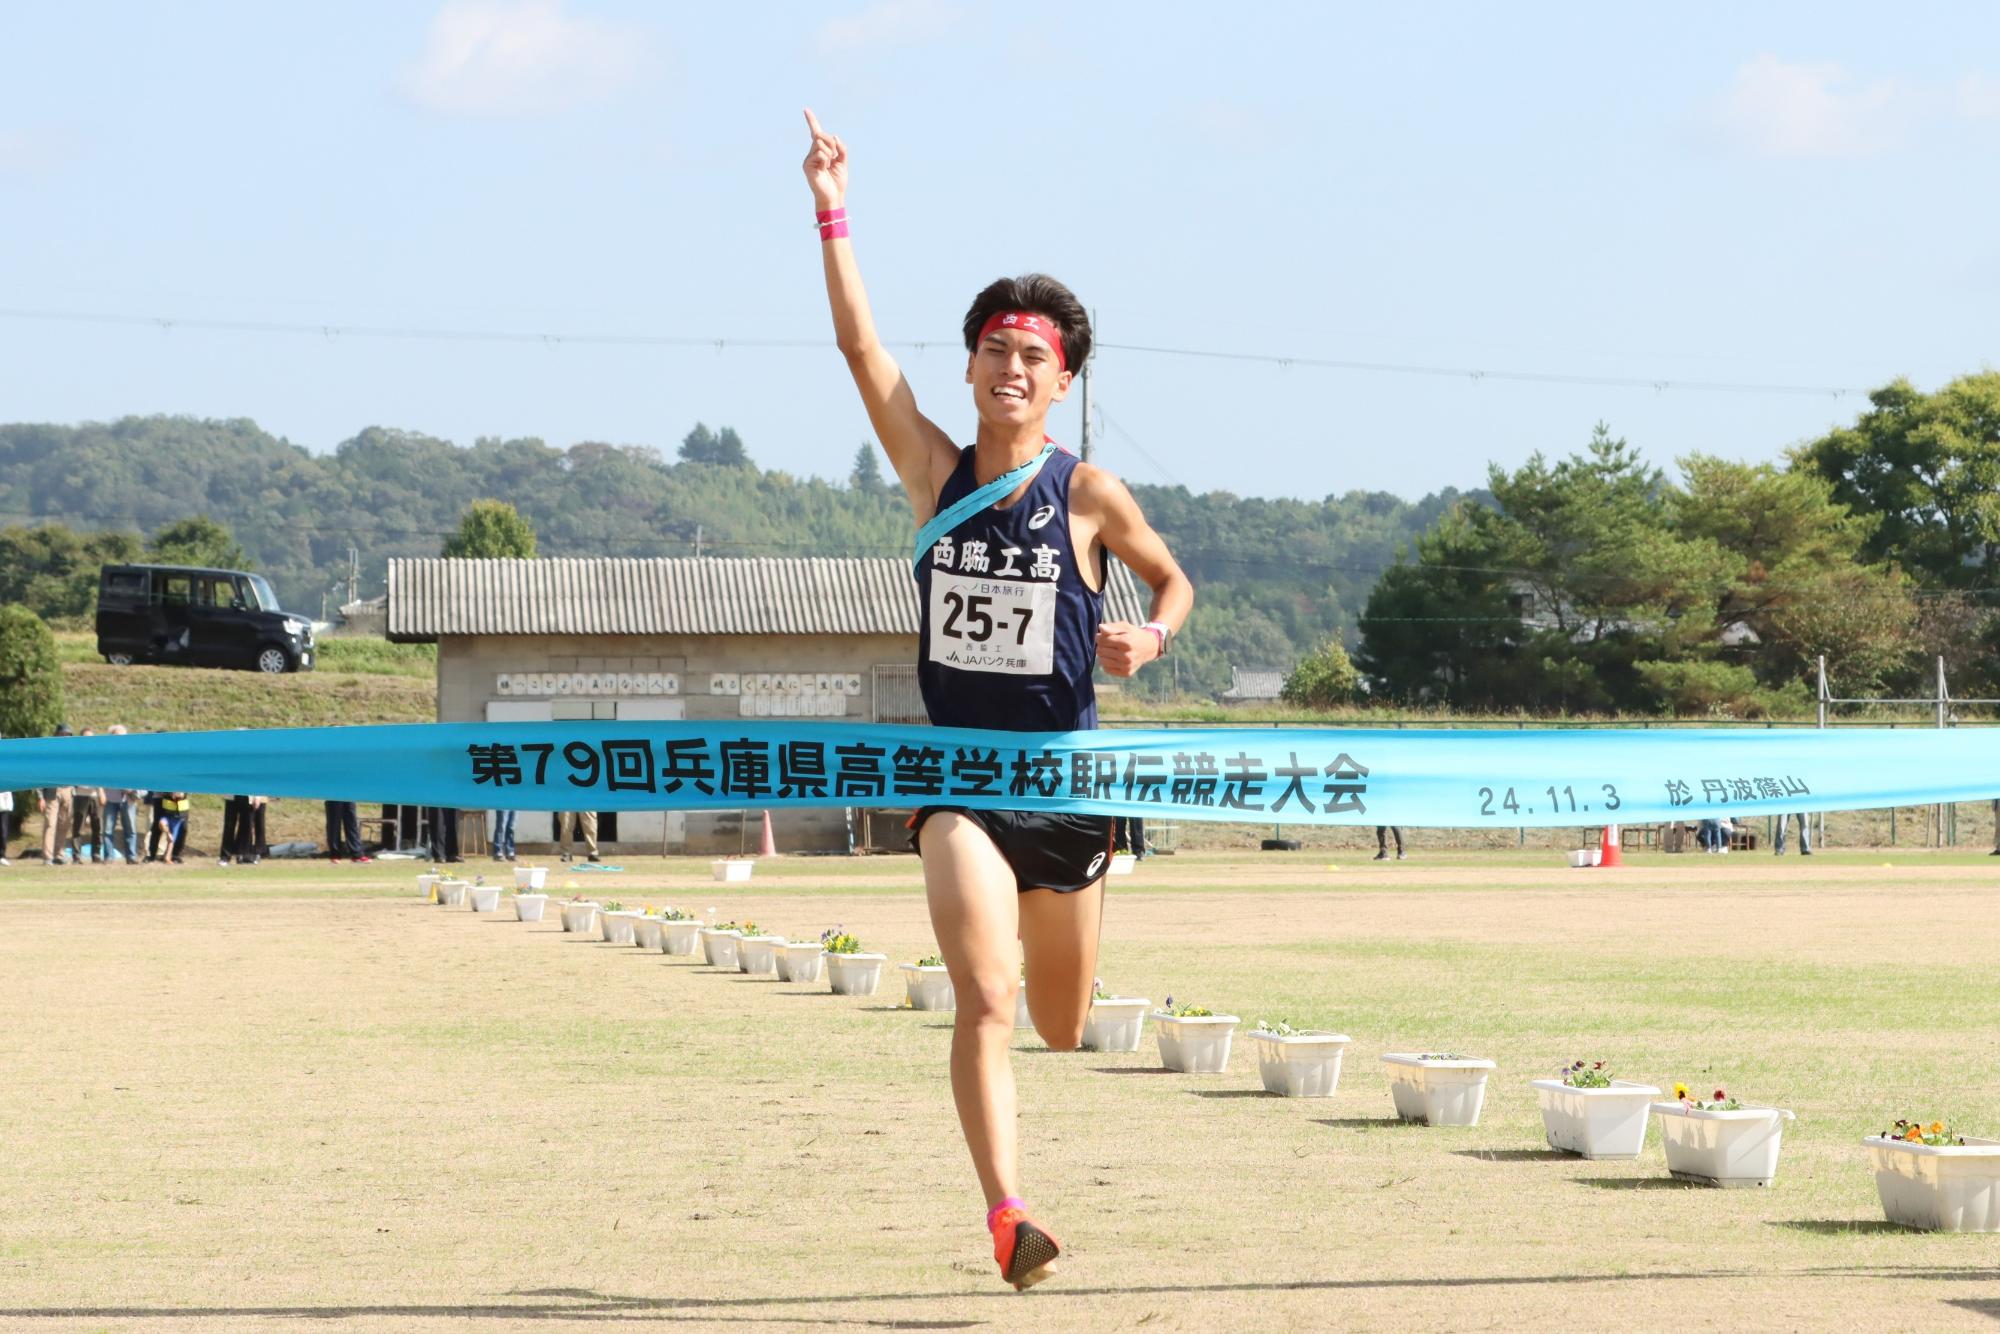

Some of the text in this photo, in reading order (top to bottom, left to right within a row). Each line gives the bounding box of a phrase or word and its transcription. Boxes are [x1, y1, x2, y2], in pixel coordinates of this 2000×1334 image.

[981, 583, 1025, 597] 日本旅行
[943, 591, 1033, 645] 25-7
[466, 737, 1369, 815] 第79回兵庫県高等学校駅伝競走大会
[1478, 783, 1622, 816] 24.11.3
